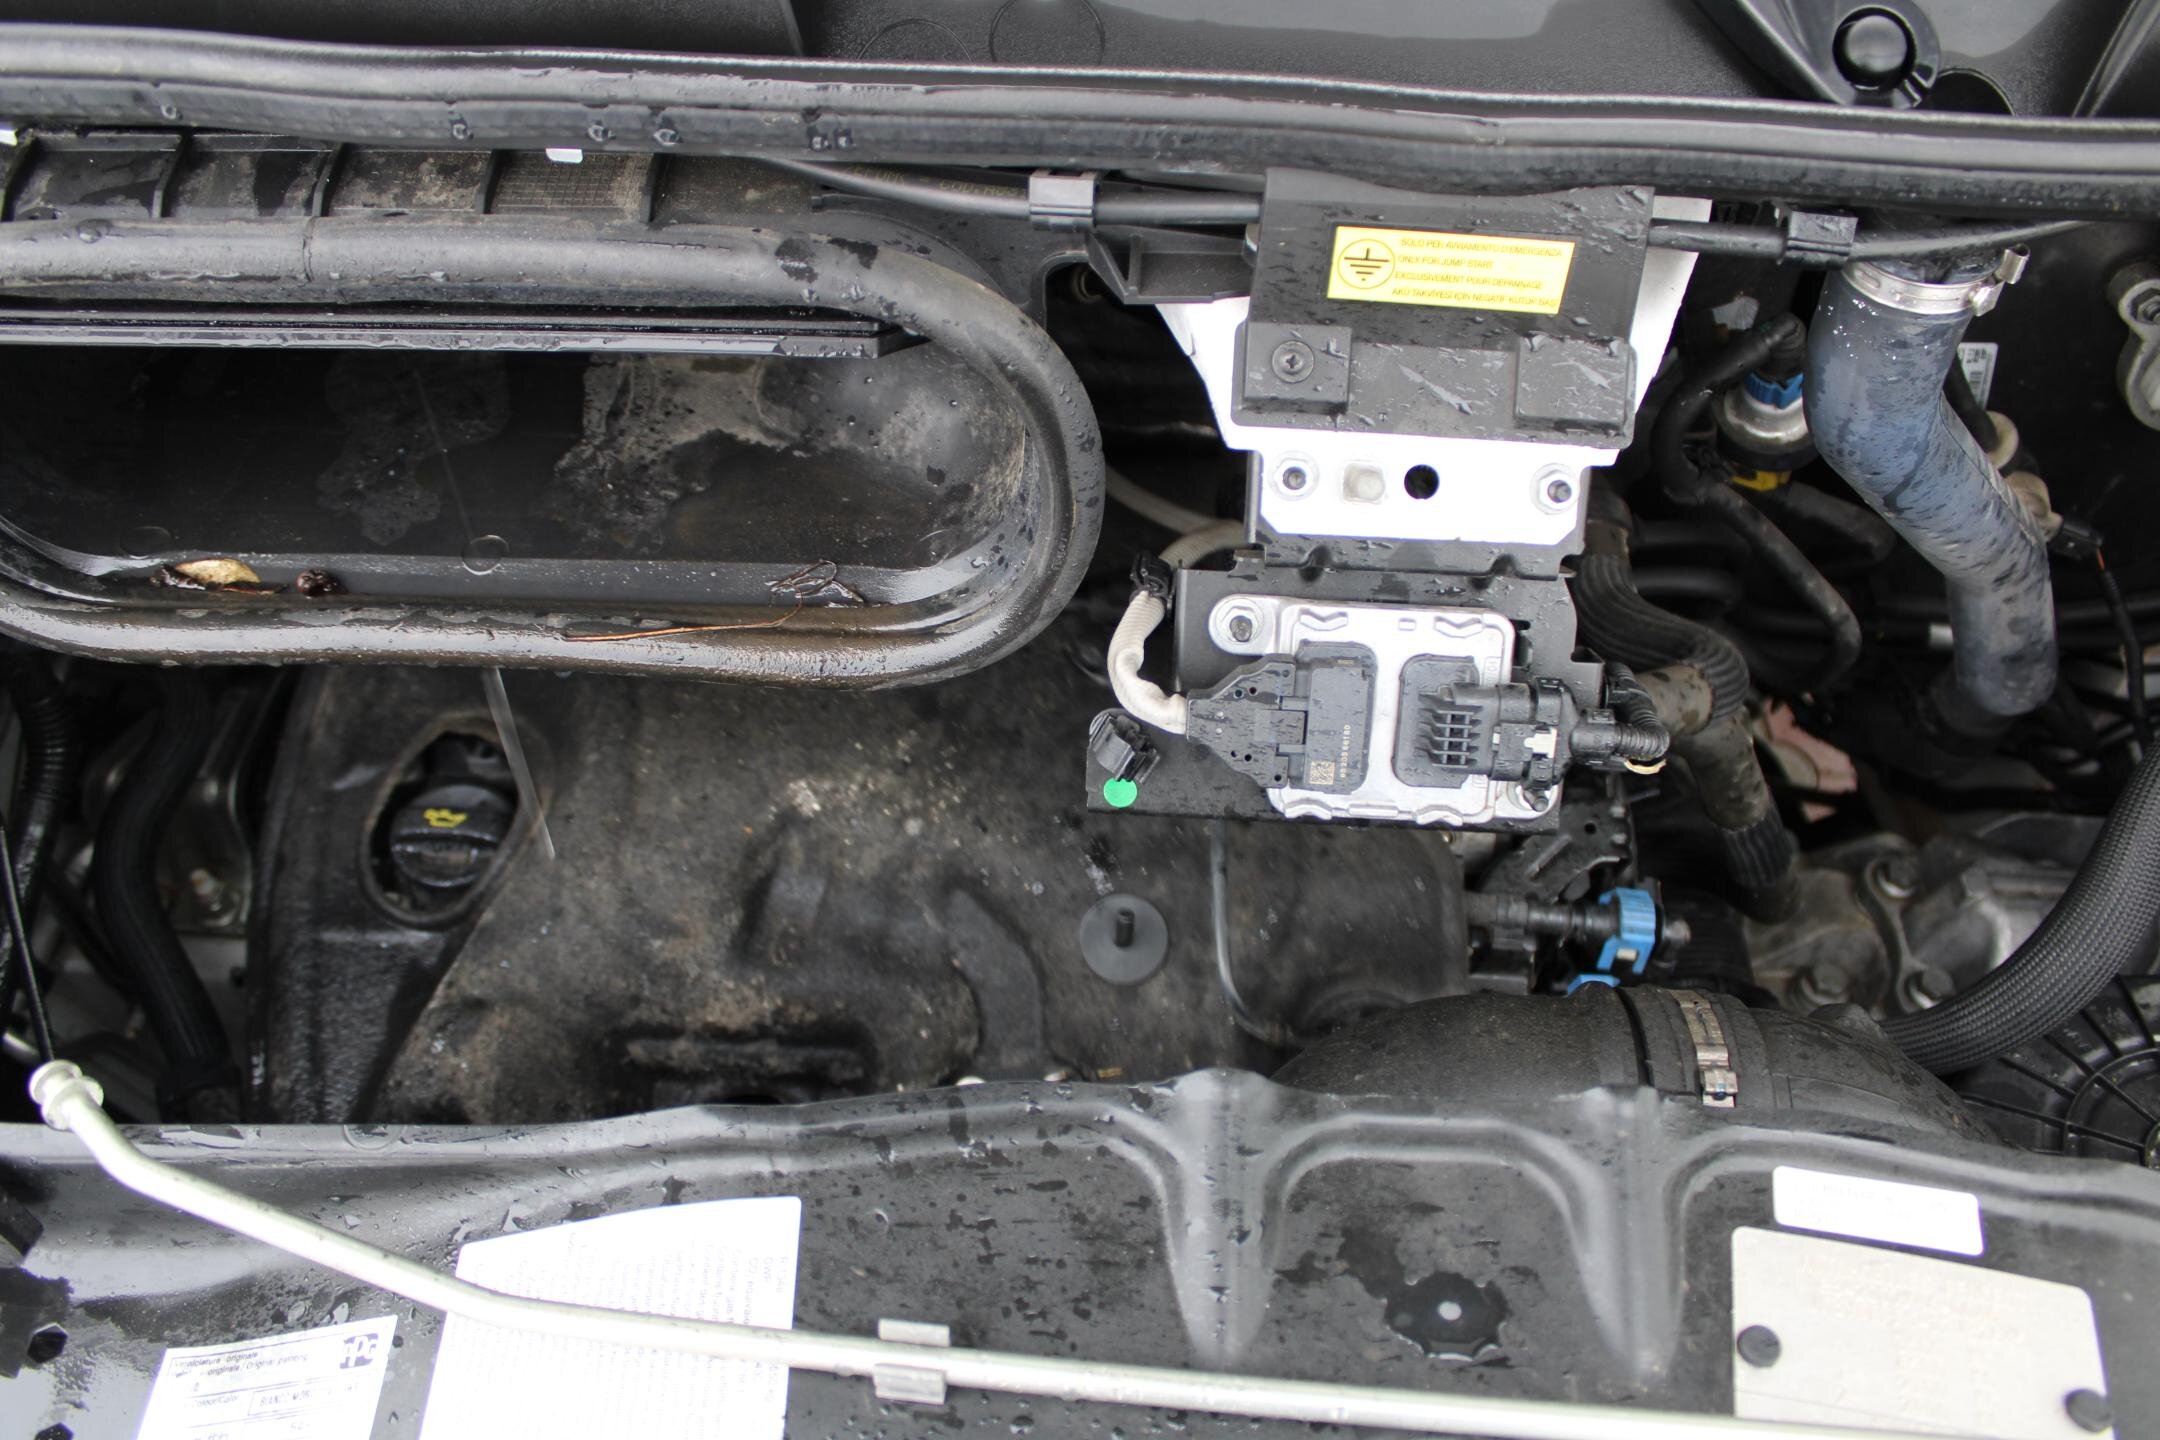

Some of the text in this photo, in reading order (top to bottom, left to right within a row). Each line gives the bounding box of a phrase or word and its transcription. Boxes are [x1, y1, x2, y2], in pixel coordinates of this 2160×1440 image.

[1398, 254, 1494, 269] ONLY FOR JUMP START
